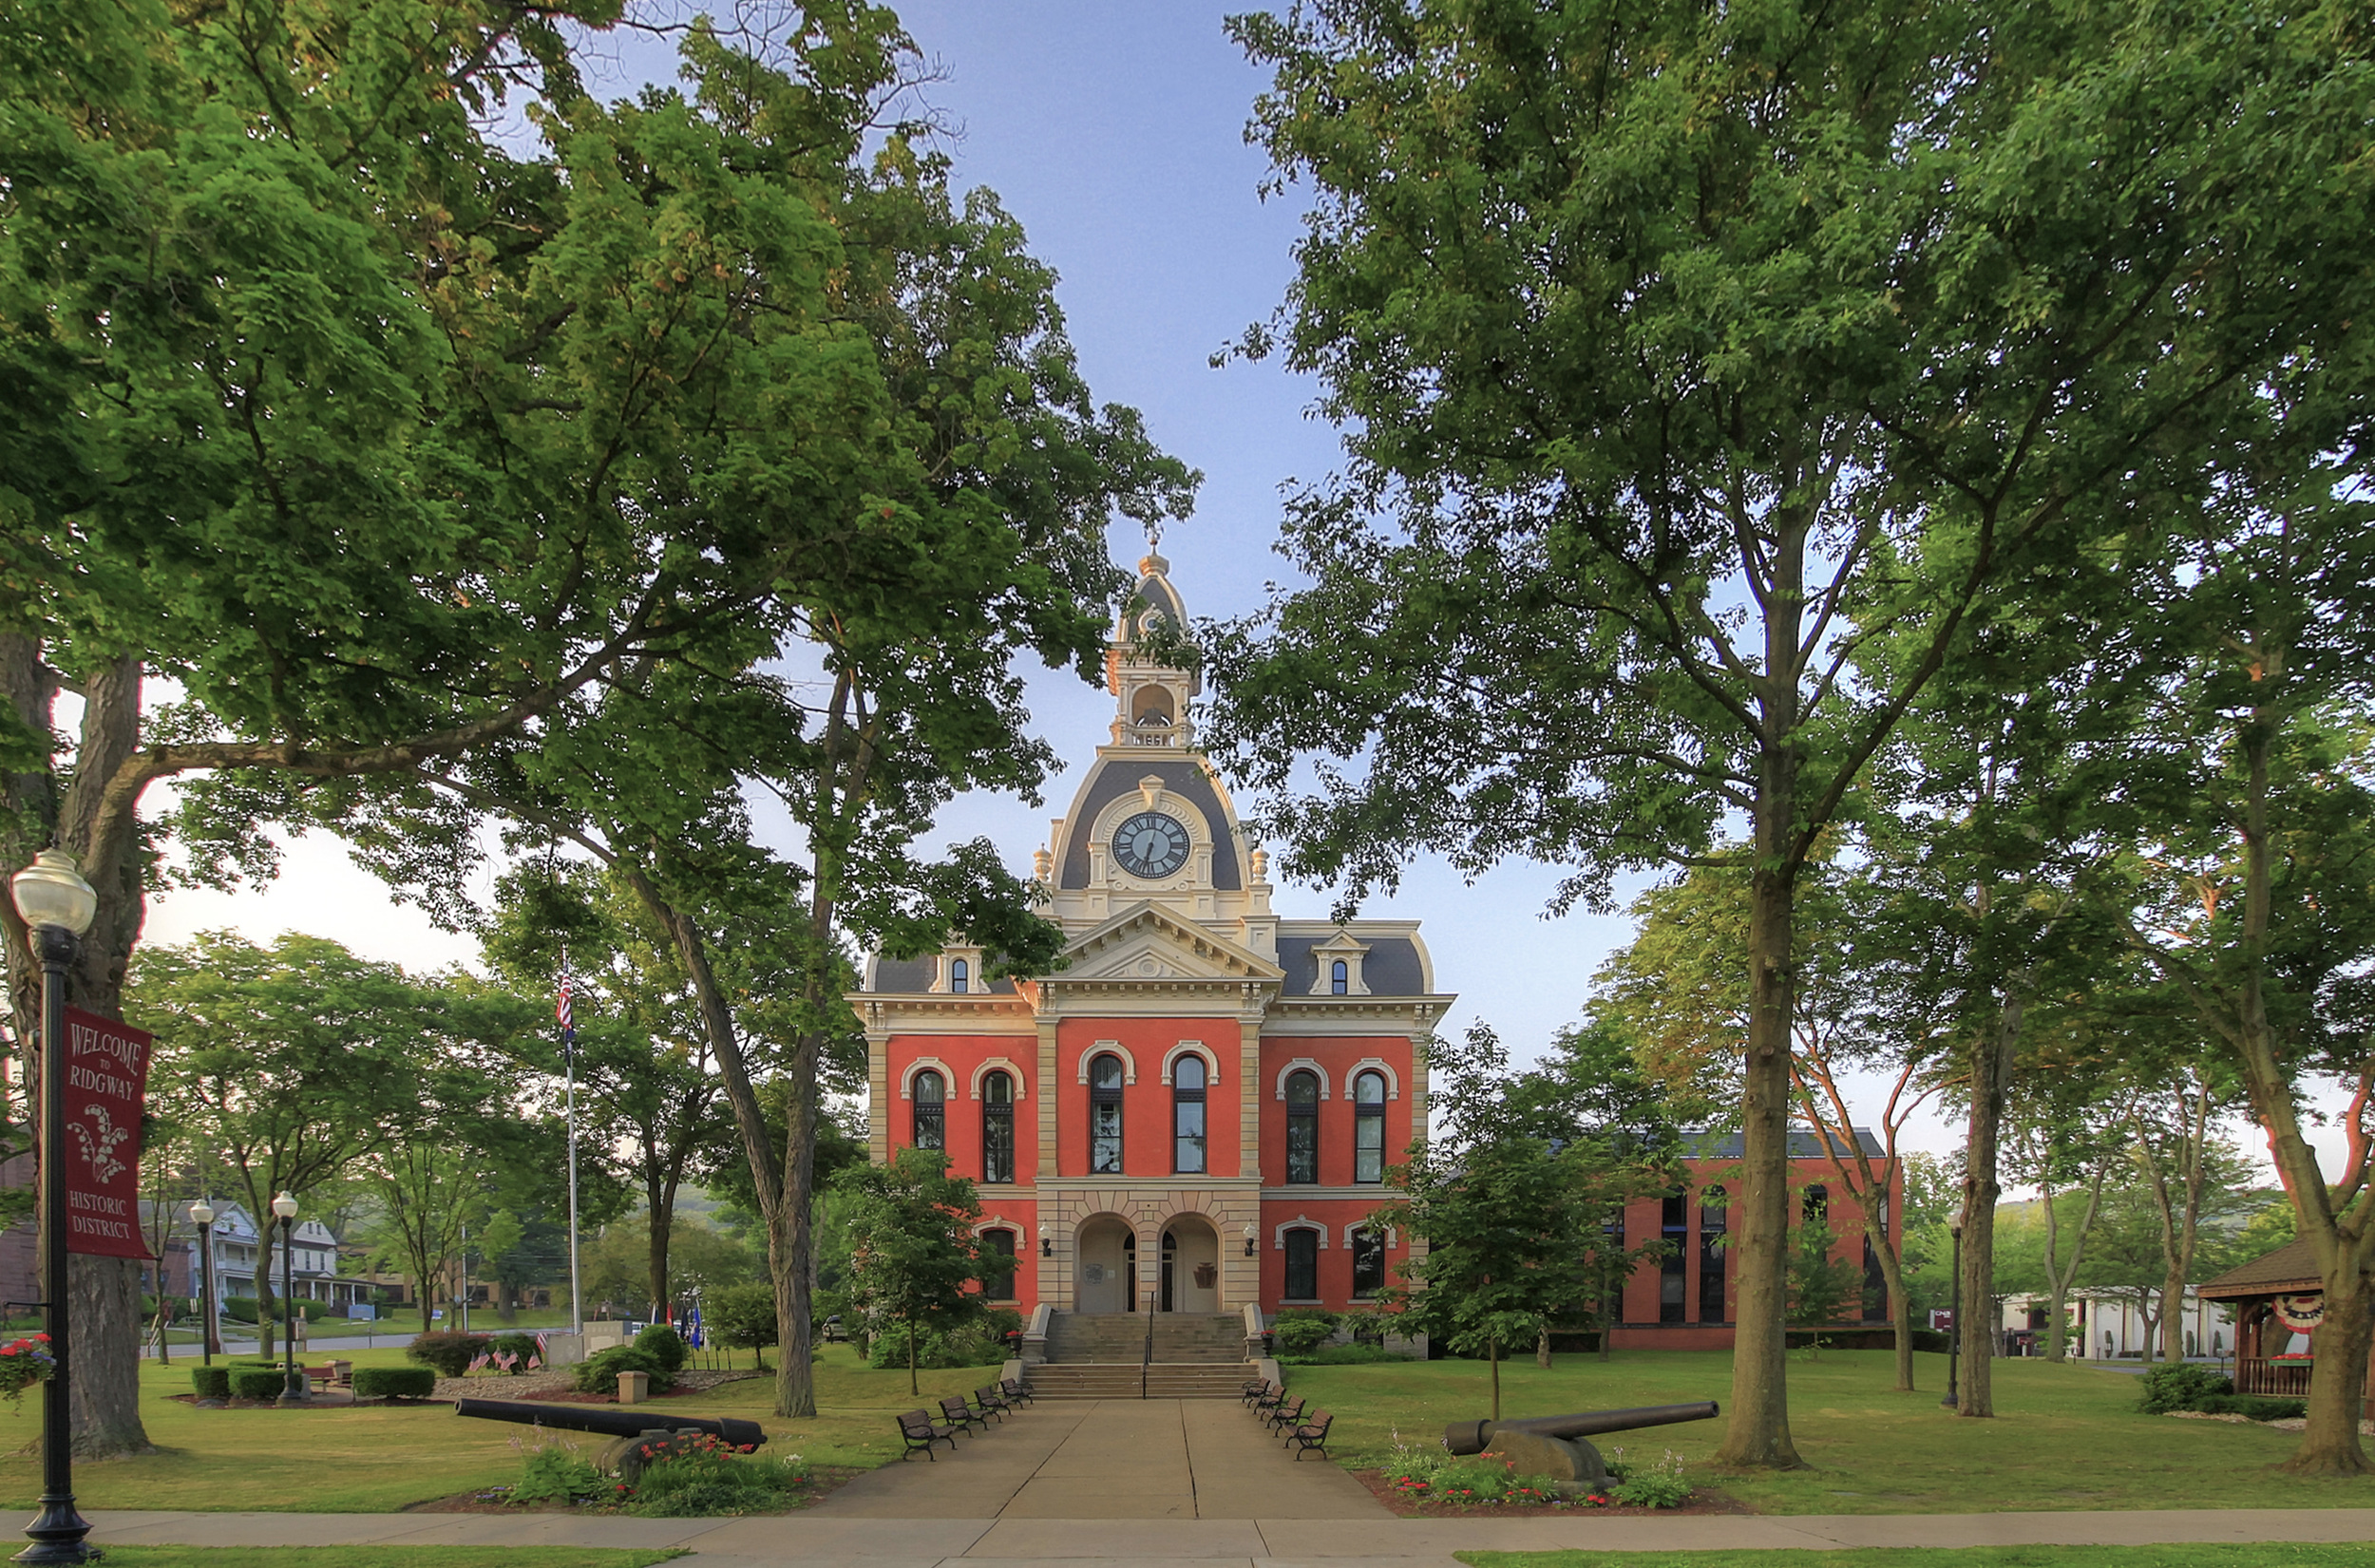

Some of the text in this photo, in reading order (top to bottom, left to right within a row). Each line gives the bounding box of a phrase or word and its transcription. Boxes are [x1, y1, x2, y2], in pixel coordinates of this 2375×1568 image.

[70, 1023, 142, 1077] WELCOME
[100, 1059, 111, 1070] TO
[69, 1065, 135, 1101] RIDGWAY
[69, 1190, 127, 1217] HISTORIC
[72, 1216, 130, 1239] DISTRICT
